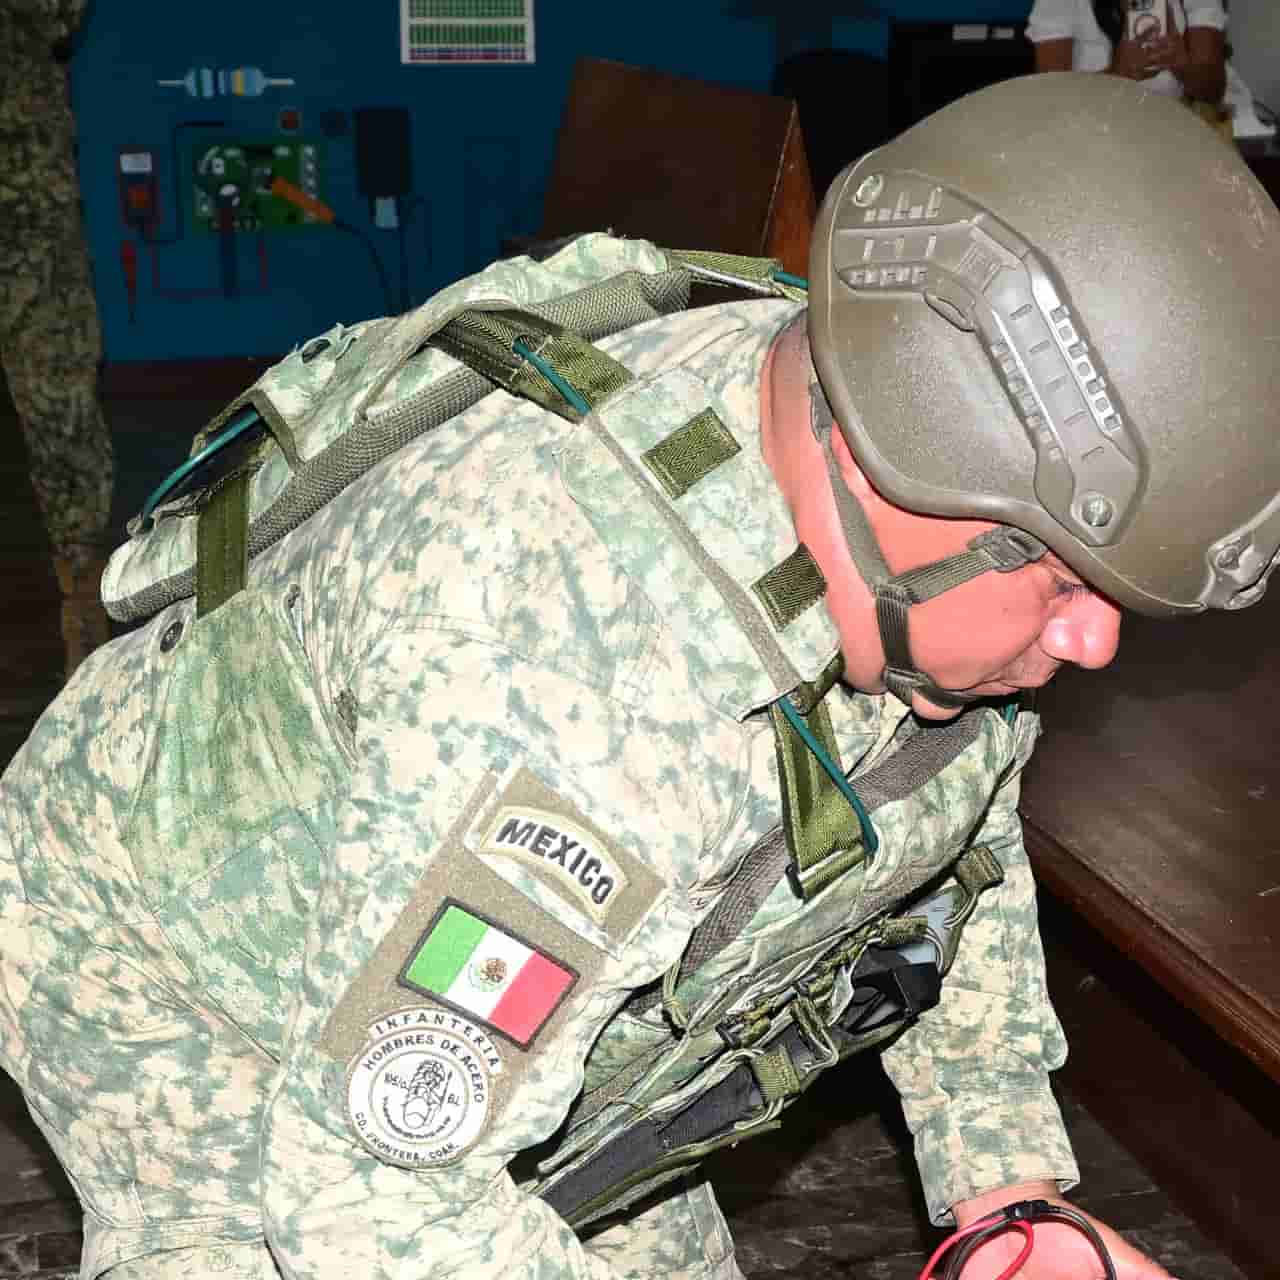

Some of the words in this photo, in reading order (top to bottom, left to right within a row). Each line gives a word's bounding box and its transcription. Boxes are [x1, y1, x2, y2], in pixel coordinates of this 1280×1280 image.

[495, 818, 614, 904] MEXICO
[364, 1034, 435, 1071] HOMBRES
[440, 1039, 461, 1056] DE
[460, 1055, 486, 1103] ACERO
[375, 1013, 500, 1067] INFANTERIA
